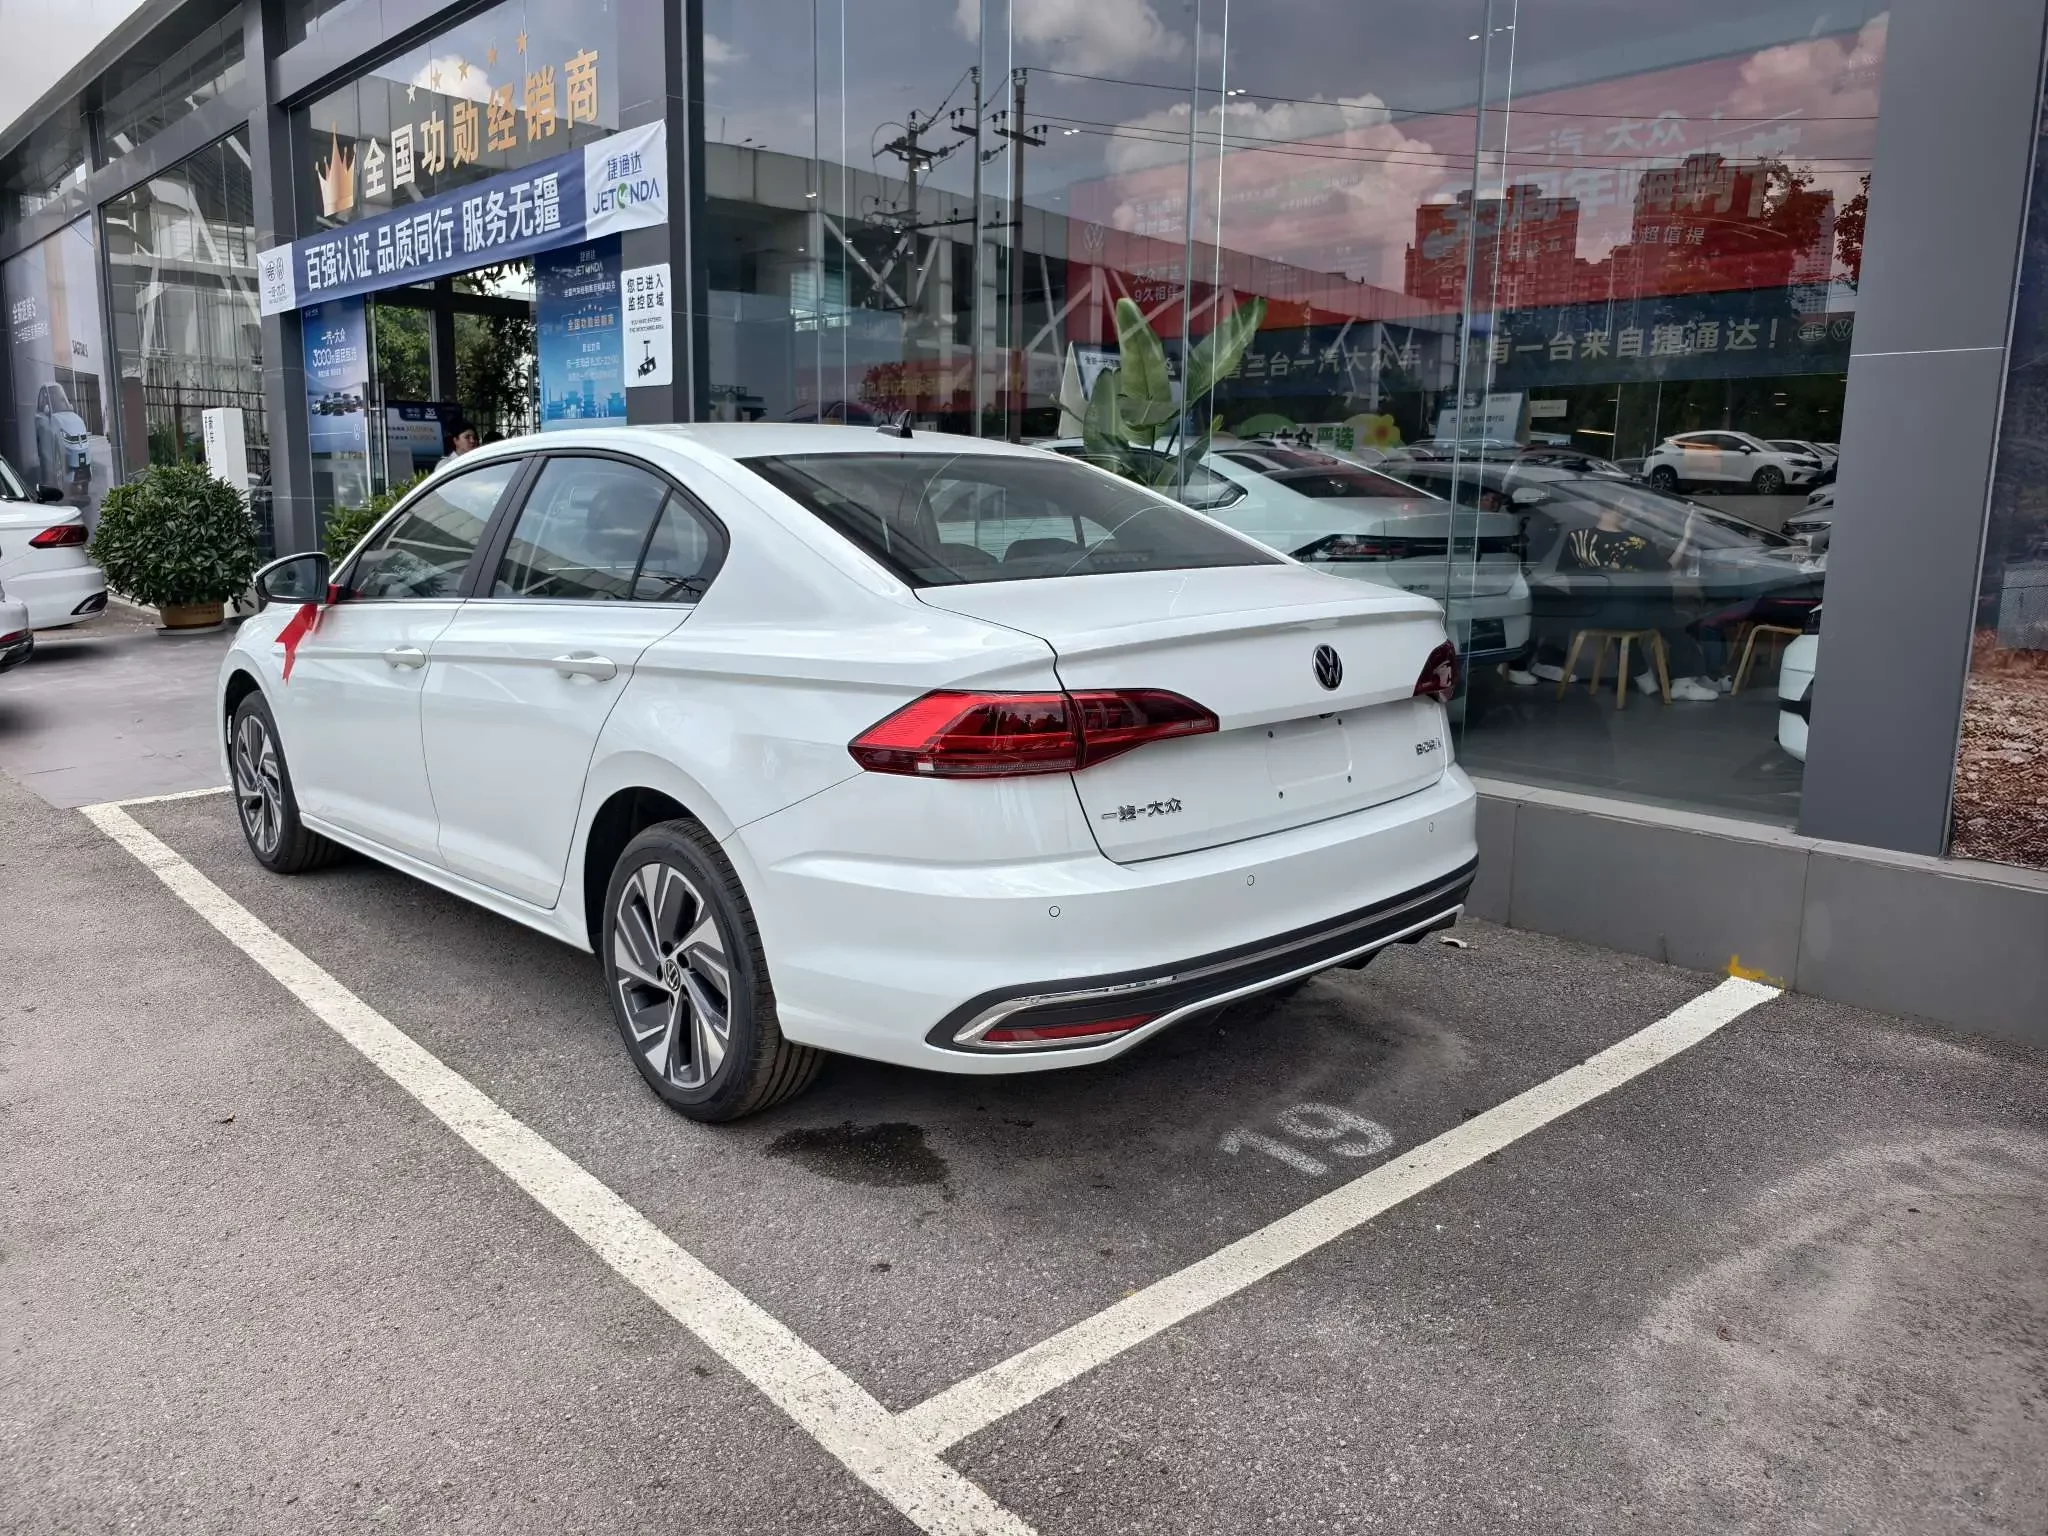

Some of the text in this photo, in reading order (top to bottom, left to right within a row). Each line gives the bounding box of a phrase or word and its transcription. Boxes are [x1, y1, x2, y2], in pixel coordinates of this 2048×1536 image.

[363, 47, 599, 199] 全国功勋经销商
[607, 150, 642, 181] 捷通达
[305, 171, 561, 293] 百强认证 品质同行 服务无疆
[627, 273, 664, 294] 您已进入
[628, 292, 665, 312] 监控区域
[1218, 1102, 1394, 1176] 19
